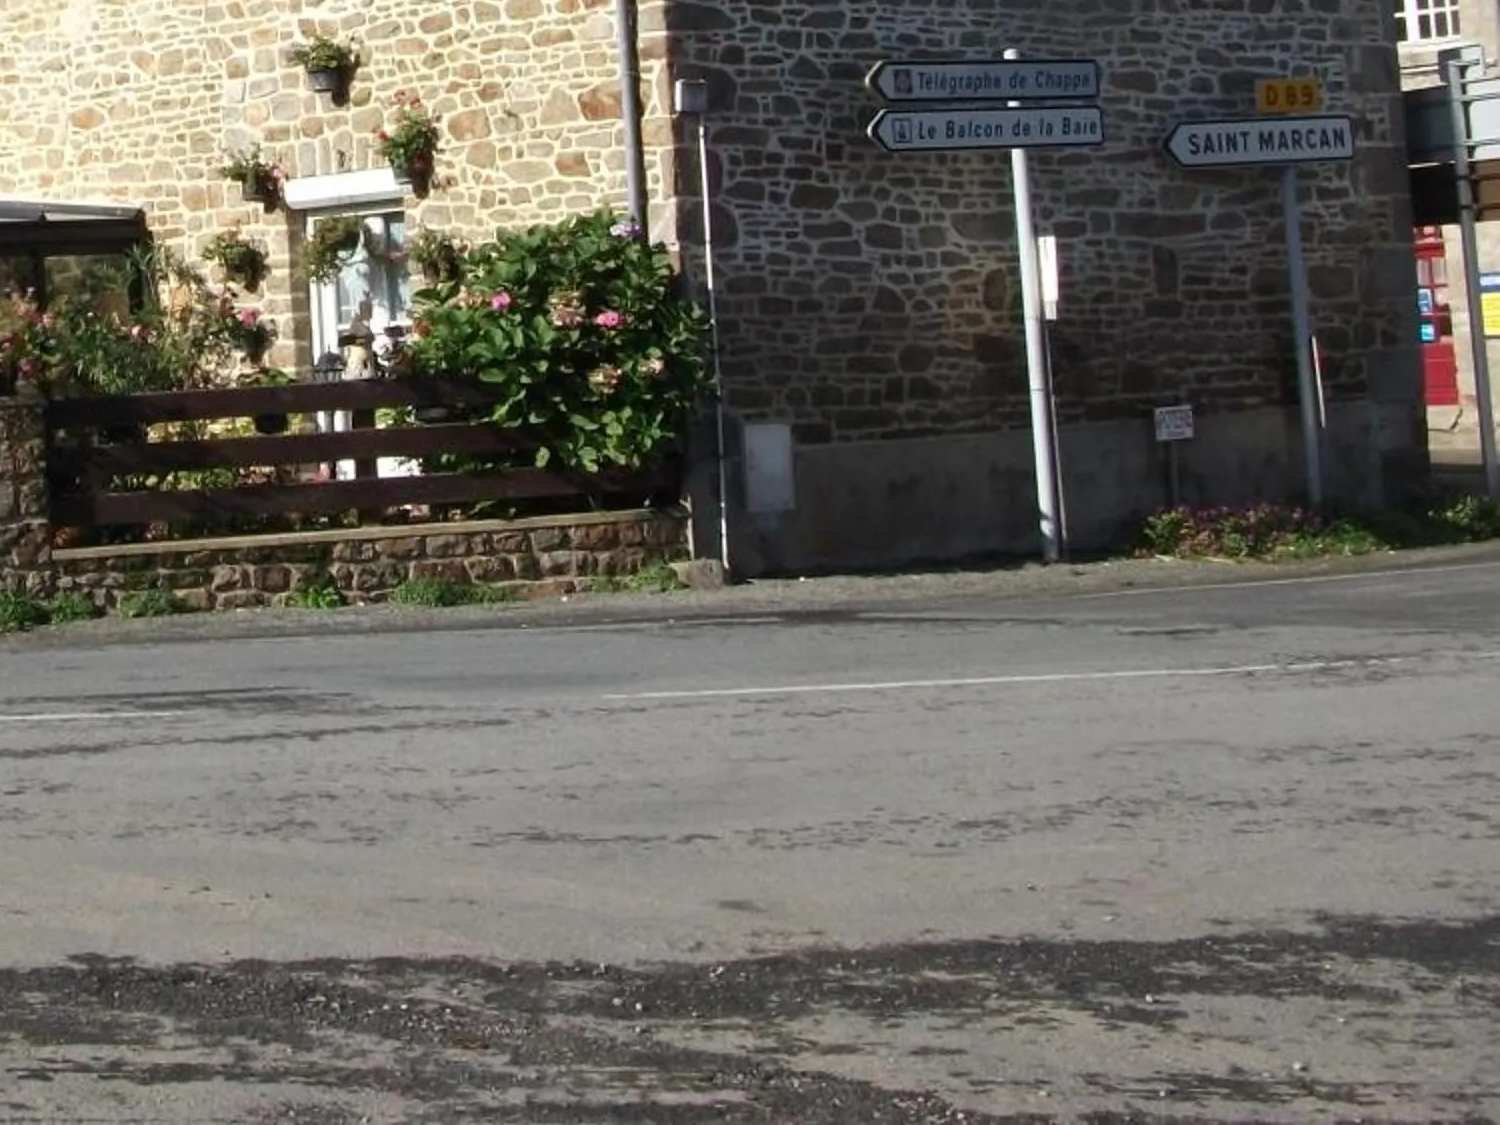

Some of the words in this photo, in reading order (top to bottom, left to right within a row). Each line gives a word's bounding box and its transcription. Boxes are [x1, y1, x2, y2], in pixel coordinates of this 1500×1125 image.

[1009, 71, 1025, 88] de
[1035, 70, 1089, 92] Chappe
[1266, 84, 1279, 106] D
[918, 121, 936, 139] Le
[946, 120, 1002, 139] Balcon
[1012, 118, 1030, 136] de
[1040, 117, 1053, 135] la
[1062, 117, 1097, 134] Baie
[1188, 131, 1250, 155] SAINT
[1259, 127, 1345, 151] MARCAN
